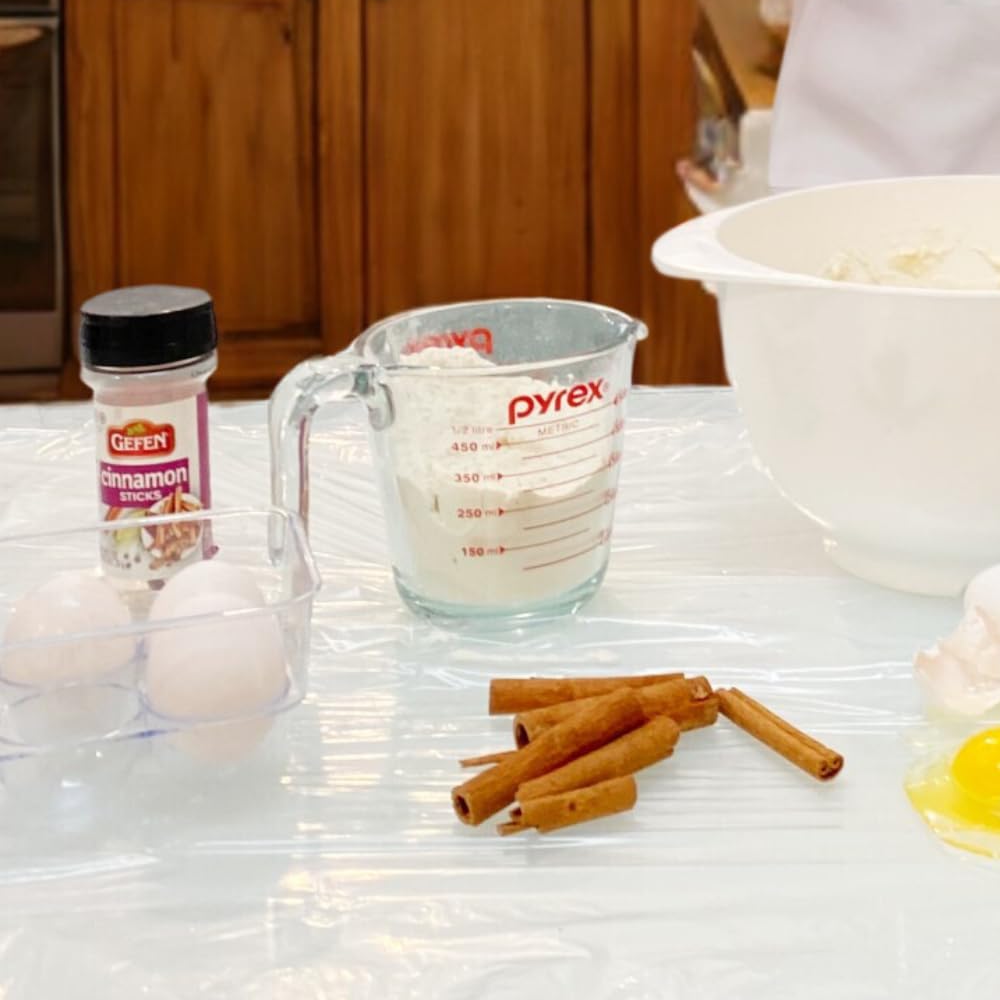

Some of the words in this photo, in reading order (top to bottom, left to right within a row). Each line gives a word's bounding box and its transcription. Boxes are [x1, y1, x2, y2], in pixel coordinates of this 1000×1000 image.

[508, 378, 604, 425] pyrex
[111, 432, 168, 451] GEFEN
[451, 441, 478, 452] 450
[101, 466, 188, 489] cinnamon
[454, 473, 480, 483] 350
[119, 490, 162, 502] STICKS
[457, 508, 482, 518] 250
[461, 546, 485, 557] 150
